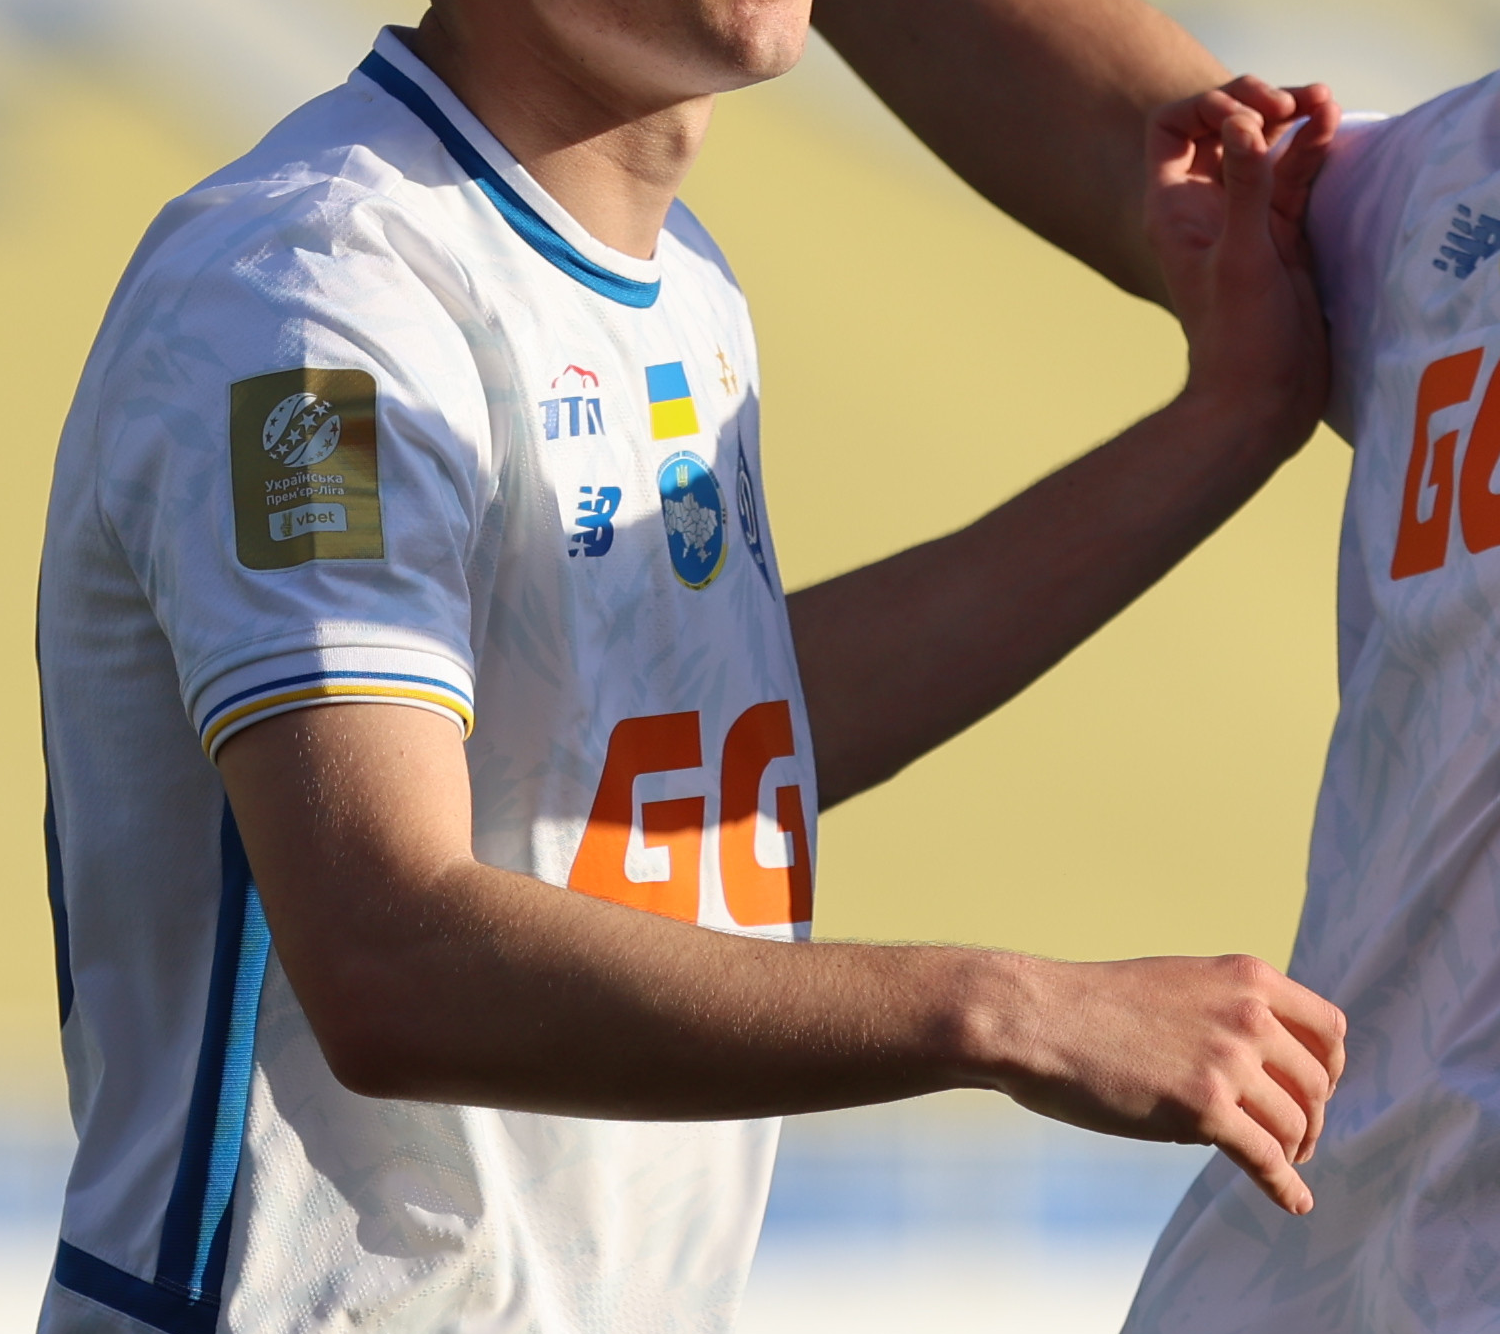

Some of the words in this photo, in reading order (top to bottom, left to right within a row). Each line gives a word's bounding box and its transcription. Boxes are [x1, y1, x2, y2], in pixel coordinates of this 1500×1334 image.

[265, 472, 343, 492] Українська
[266, 485, 345, 506] Прем'єр-Ліга
[296, 511, 335, 526] vbet
[567, 699, 813, 927] GG
